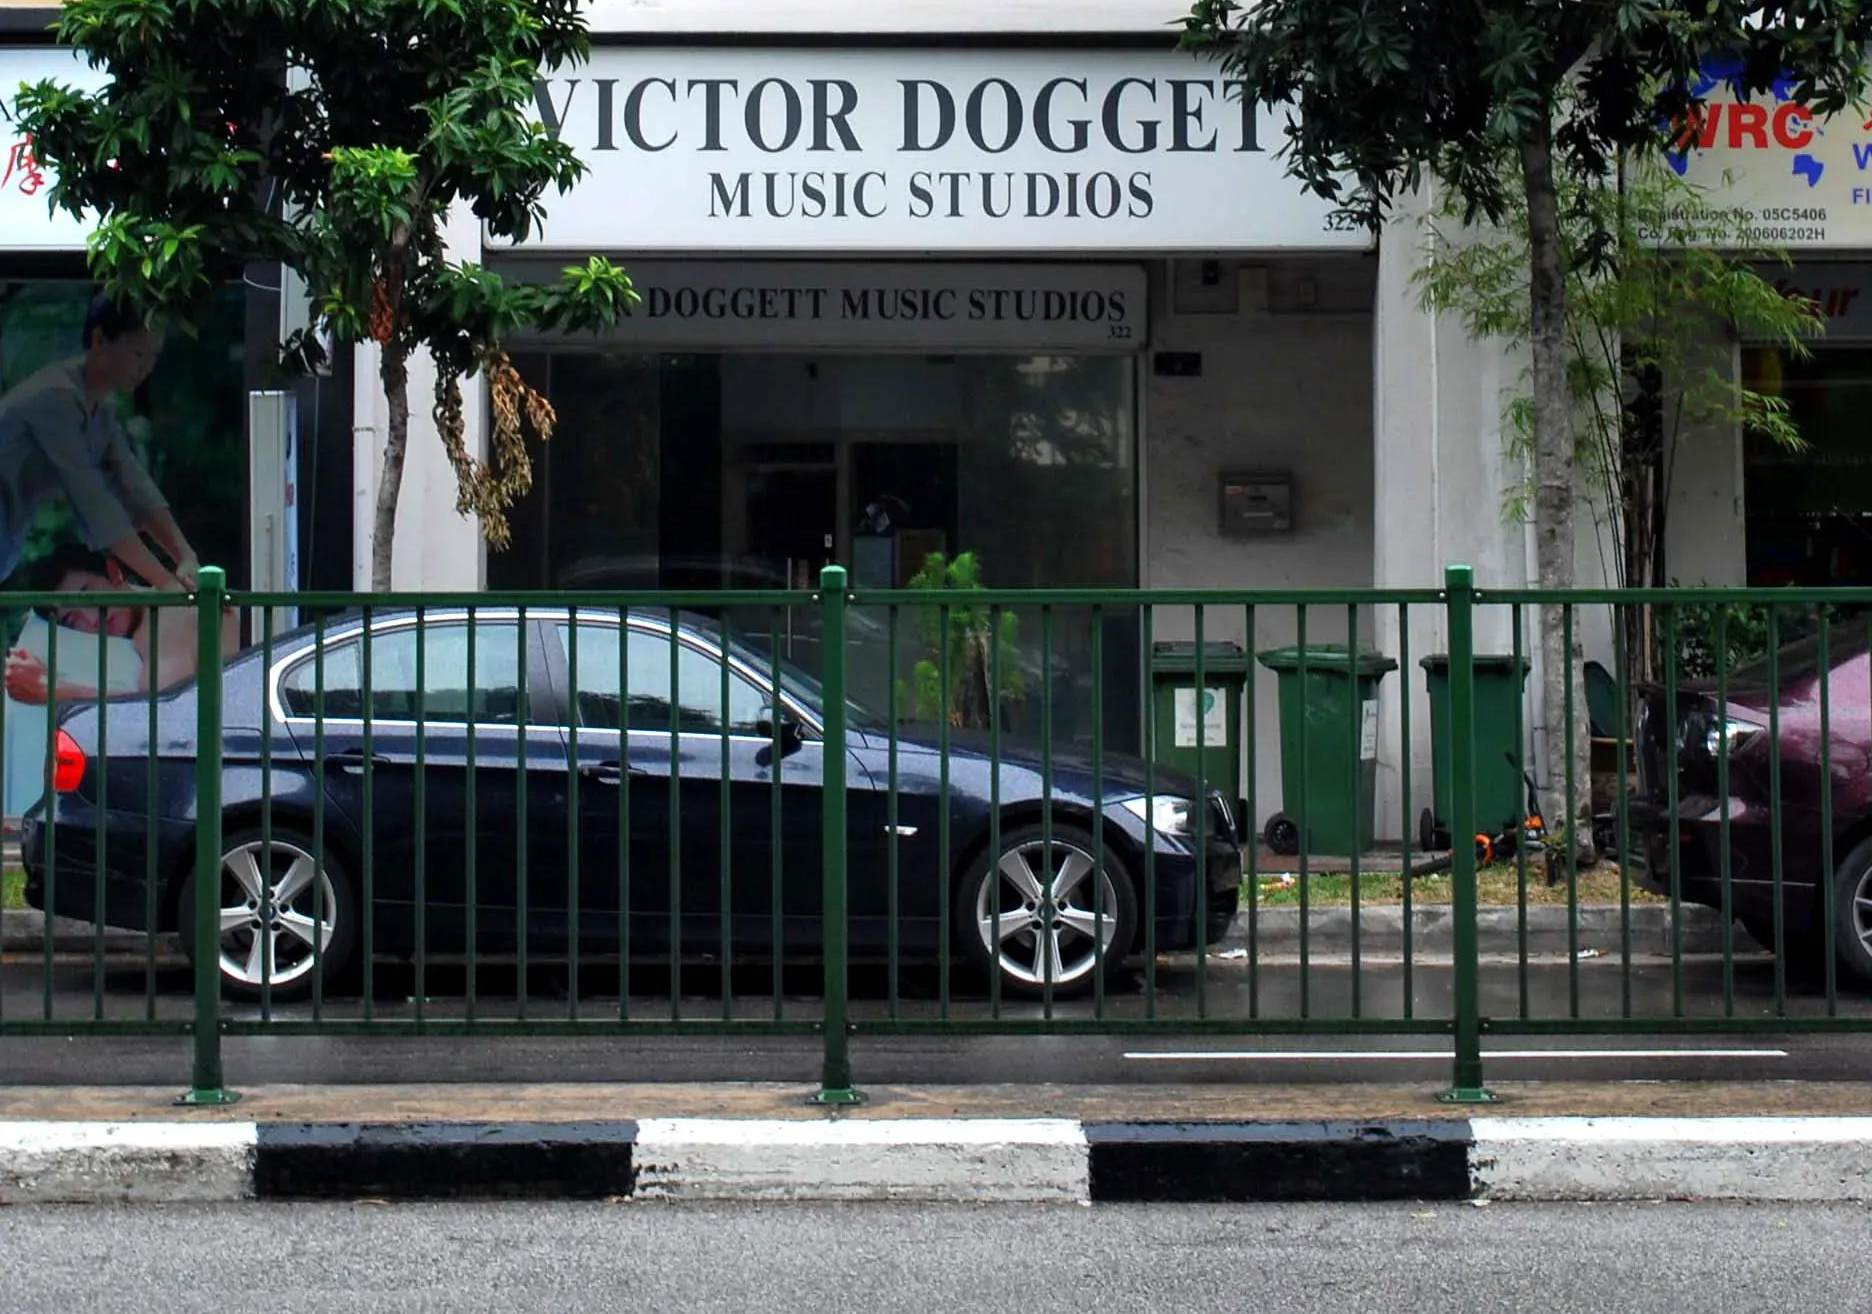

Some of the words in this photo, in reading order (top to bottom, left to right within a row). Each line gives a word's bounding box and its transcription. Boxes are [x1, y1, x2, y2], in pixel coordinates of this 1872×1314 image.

[534, 77, 862, 153] VICTOR
[898, 76, 1308, 154] DOGGET
[708, 171, 887, 219] MUSIC
[908, 170, 1155, 220] STUDIOS
[1322, 214, 1355, 231] 322
[1762, 208, 1827, 222] 05C5406
[647, 287, 828, 319] DOGGETT
[840, 288, 958, 321] MUSIC
[967, 289, 1127, 322] STUDIOS
[1107, 325, 1133, 339] 322
